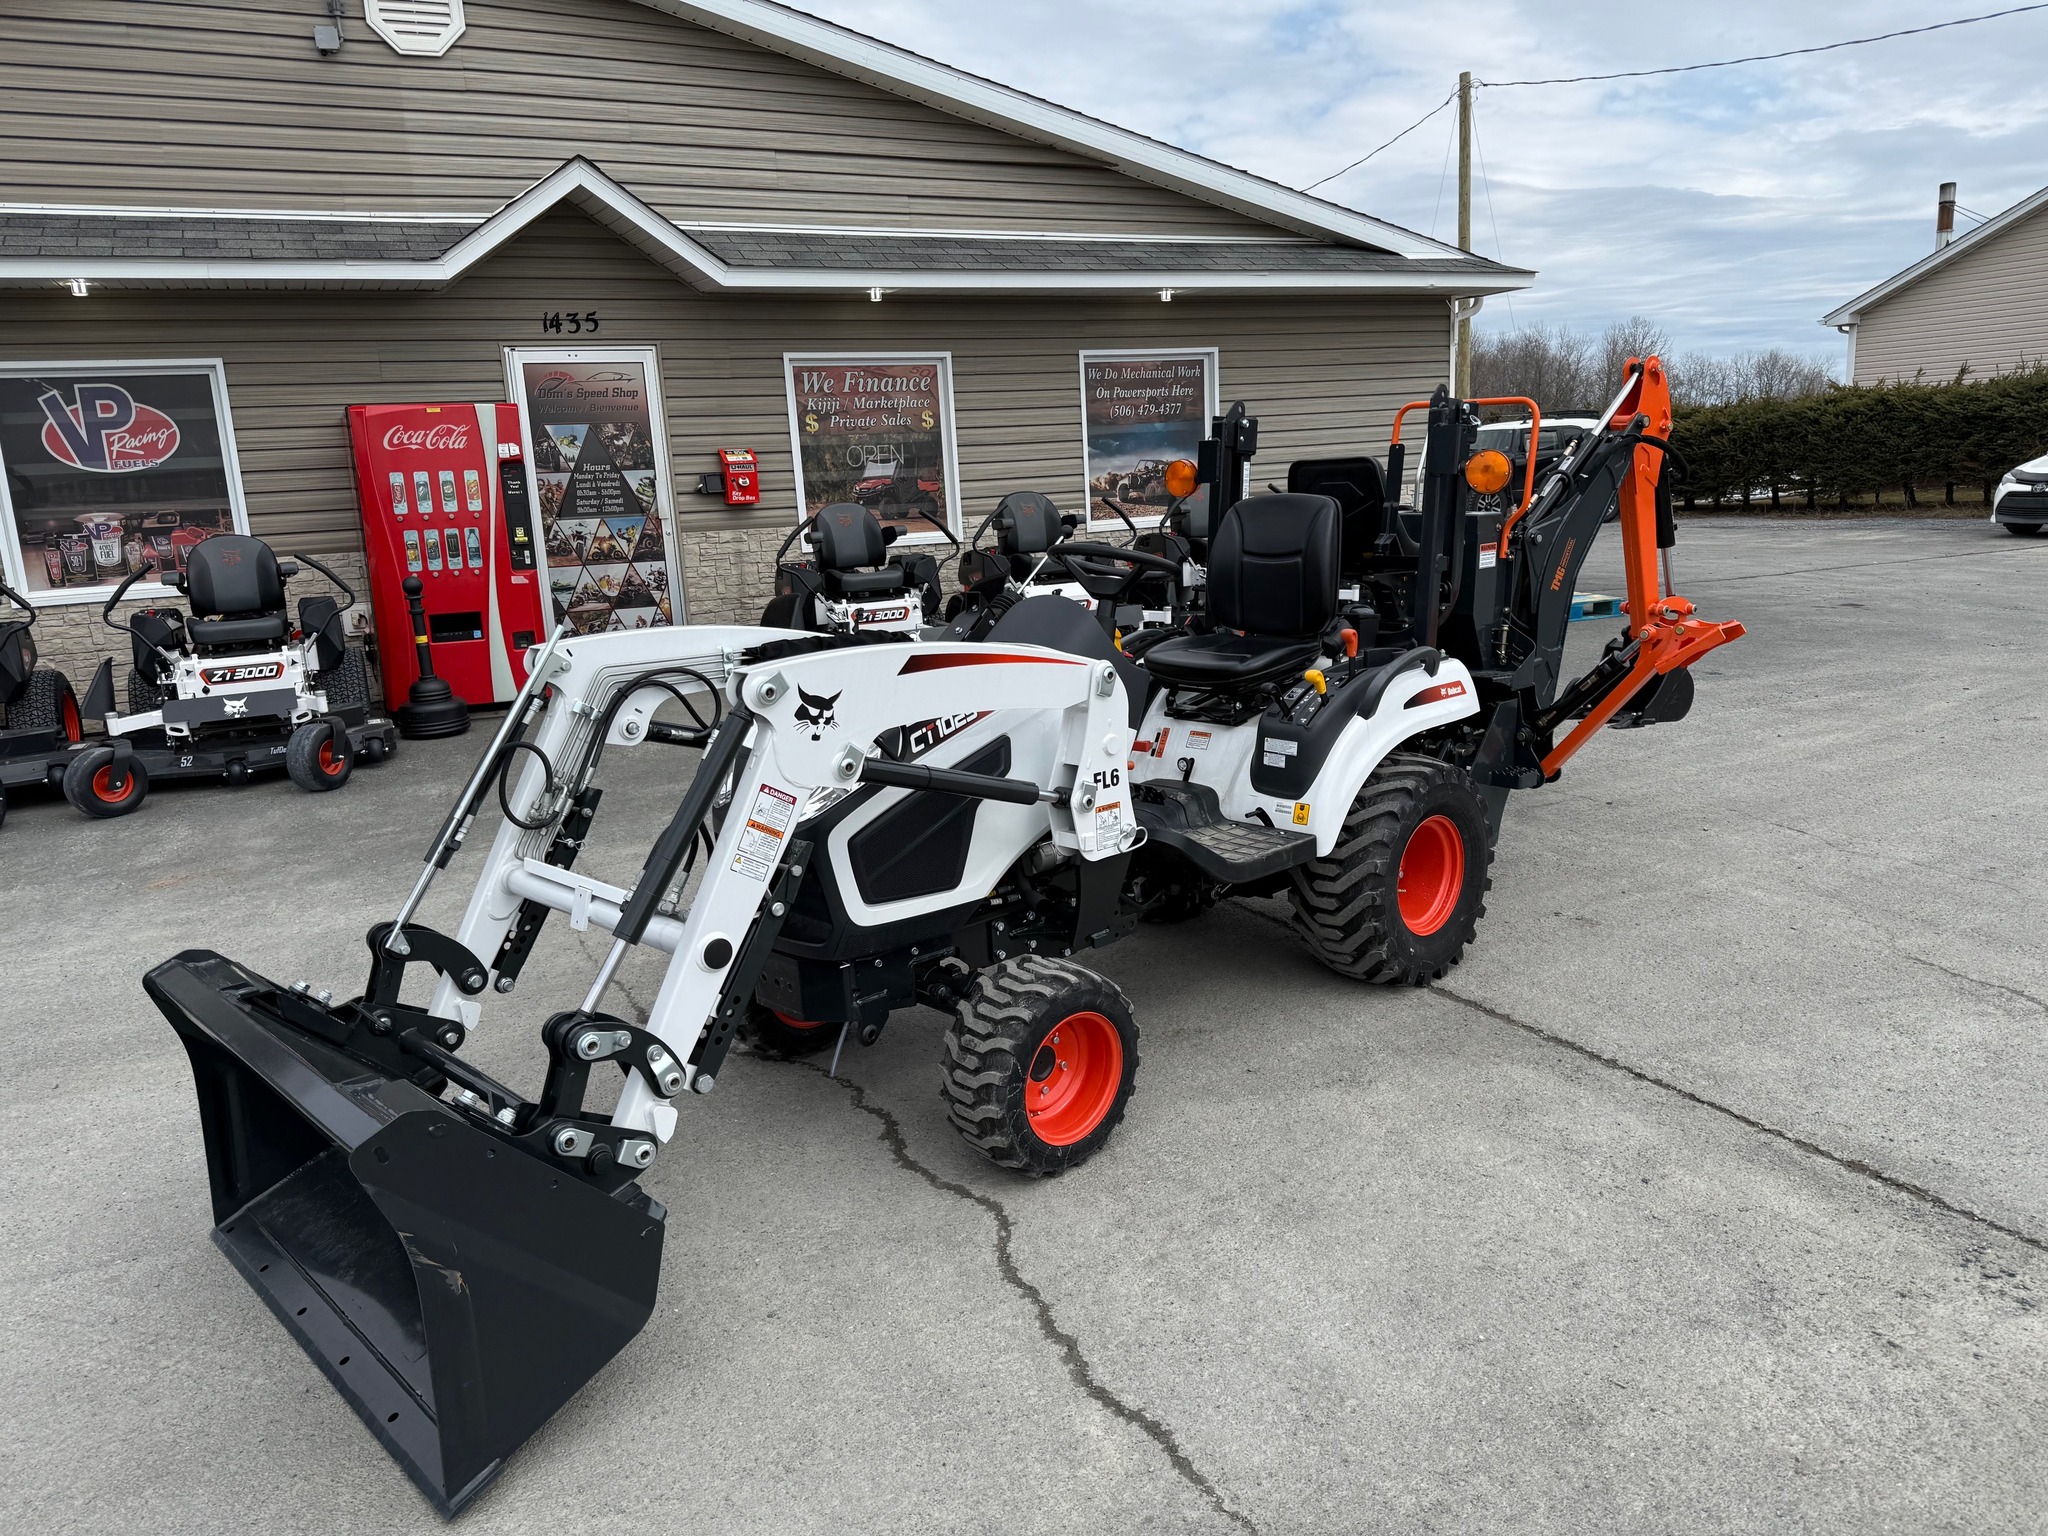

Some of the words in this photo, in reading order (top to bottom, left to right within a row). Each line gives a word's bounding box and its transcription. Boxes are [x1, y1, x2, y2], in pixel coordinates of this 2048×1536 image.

[542, 311, 599, 334] 1435
[1088, 368, 1101, 380] We
[1104, 367, 1118, 380] Do
[1120, 366, 1175, 379] Mechanical
[1177, 365, 1201, 377] Work
[801, 371, 834, 394] We
[842, 370, 931, 393] Finance
[538, 388, 573, 399] Dom's
[576, 387, 609, 400] Speed
[612, 387, 639, 400] Shop
[1096, 386, 1110, 399] On
[1113, 386, 1169, 401] Powersports
[1171, 384, 1194, 396] Here
[539, 404, 582, 414] Welcome
[589, 403, 639, 413] Bienvenue
[806, 397, 841, 414] Kijiji
[843, 397, 849, 410] /
[853, 395, 930, 412] Marketplace
[1110, 404, 1135, 419] (506)
[1137, 403, 1182, 416] 479-4377
[37, 383, 136, 471] VP
[830, 414, 877, 428] Private
[880, 413, 912, 426] Sales
[109, 427, 177, 459] Racing
[382, 424, 472, 450] Coca-Cola
[846, 444, 905, 467] OPEN
[113, 459, 160, 470] FUELS
[582, 463, 611, 471] Hours
[603, 472, 620, 480] Friday
[576, 498, 600, 506] Saturday
[604, 497, 624, 505] Samedi
[100, 550, 116, 559] FUEL
[1550, 566, 1566, 591] TMG
[858, 609, 905, 622] ZT3000
[211, 665, 278, 682] ZT3000
[1447, 685, 1462, 696] Bobcat
[270, 746, 287, 755] TufDe
[180, 756, 193, 768] 52
[1093, 768, 1120, 790] FL6
[770, 789, 794, 803] DANGER
[756, 823, 781, 837] WARNING
